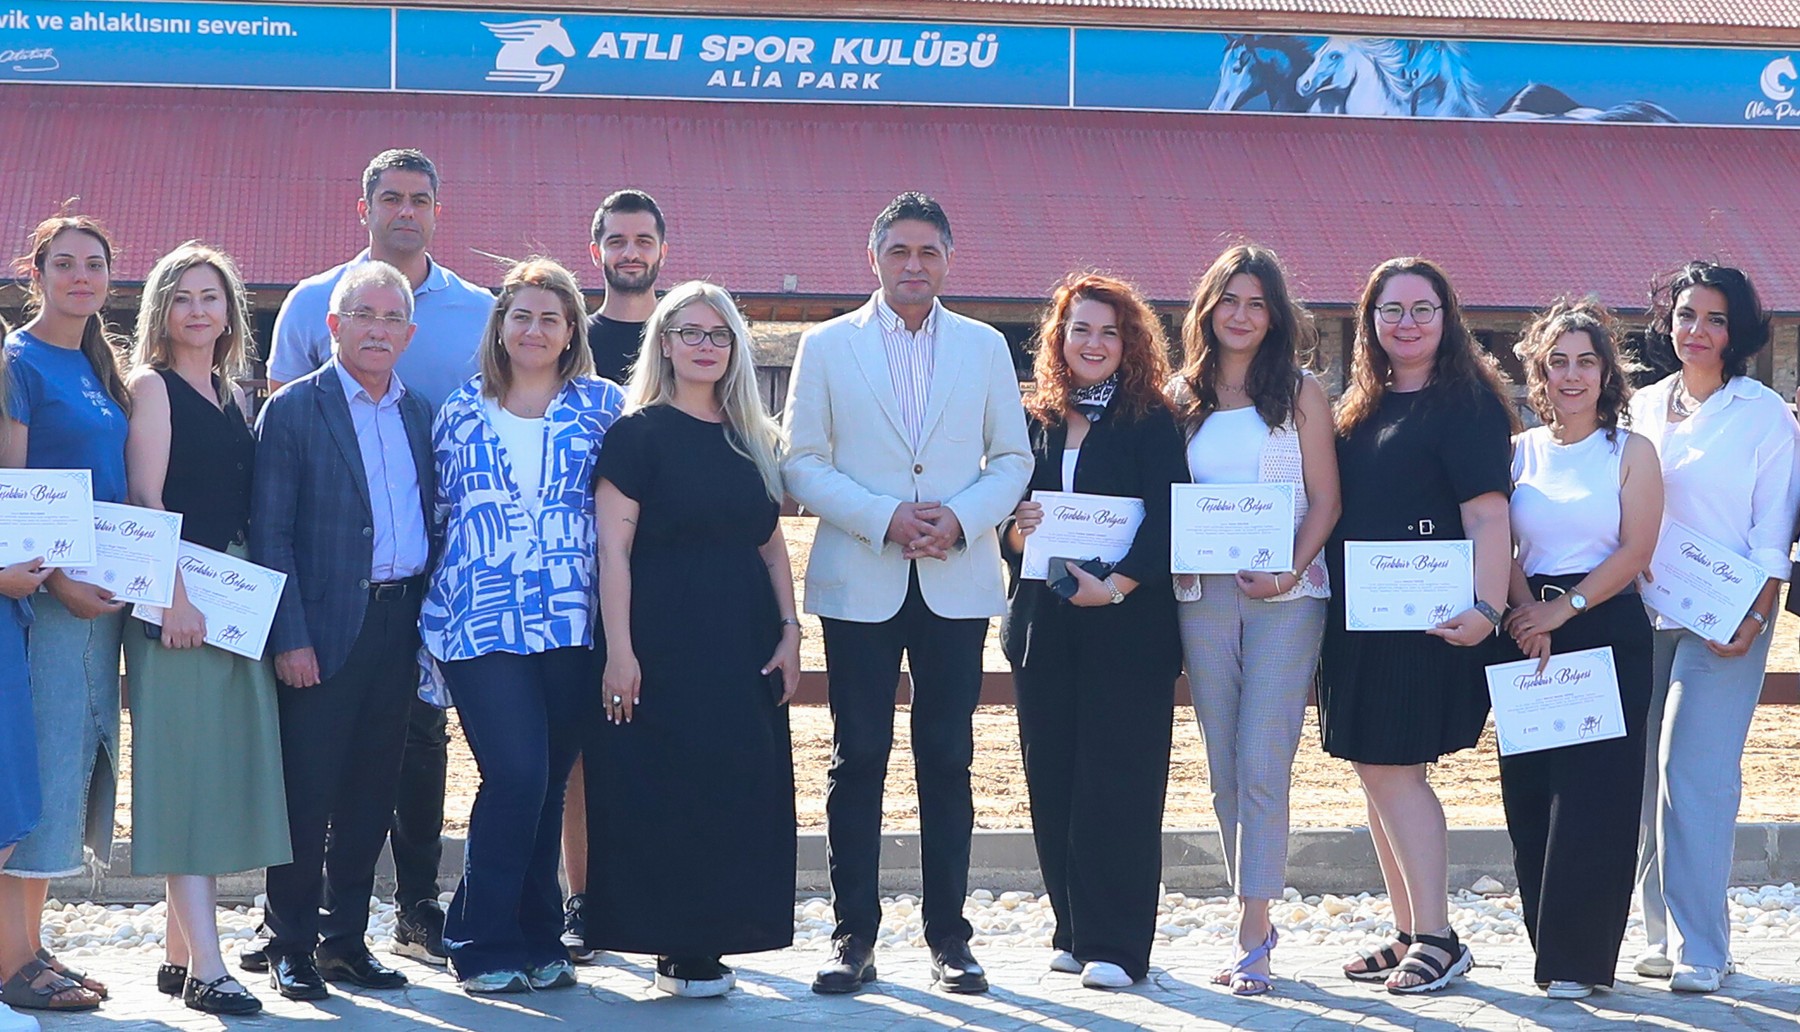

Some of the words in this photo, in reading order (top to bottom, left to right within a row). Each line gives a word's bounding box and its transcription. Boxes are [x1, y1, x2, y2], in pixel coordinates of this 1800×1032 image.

[36, 14, 63, 30] ve
[70, 11, 191, 33] ahlaklısını
[197, 16, 298, 36] severim.
[587, 31, 683, 61] ATLI
[699, 34, 815, 64] SPOR
[831, 31, 999, 69] KULÜBÜ
[797, 71, 882, 90] PARK
[1744, 100, 1774, 120] Alia
[30, 484, 69, 505] Belgesi
[1237, 496, 1274, 516] Belgesi
[1093, 509, 1128, 528] Belgesi
[119, 520, 157, 541] Belgesi
[1412, 554, 1450, 573] Belgesi
[1712, 561, 1743, 584] Belgesi
[219, 570, 258, 592] Belgesi
[1554, 667, 1592, 686] Belgesi
